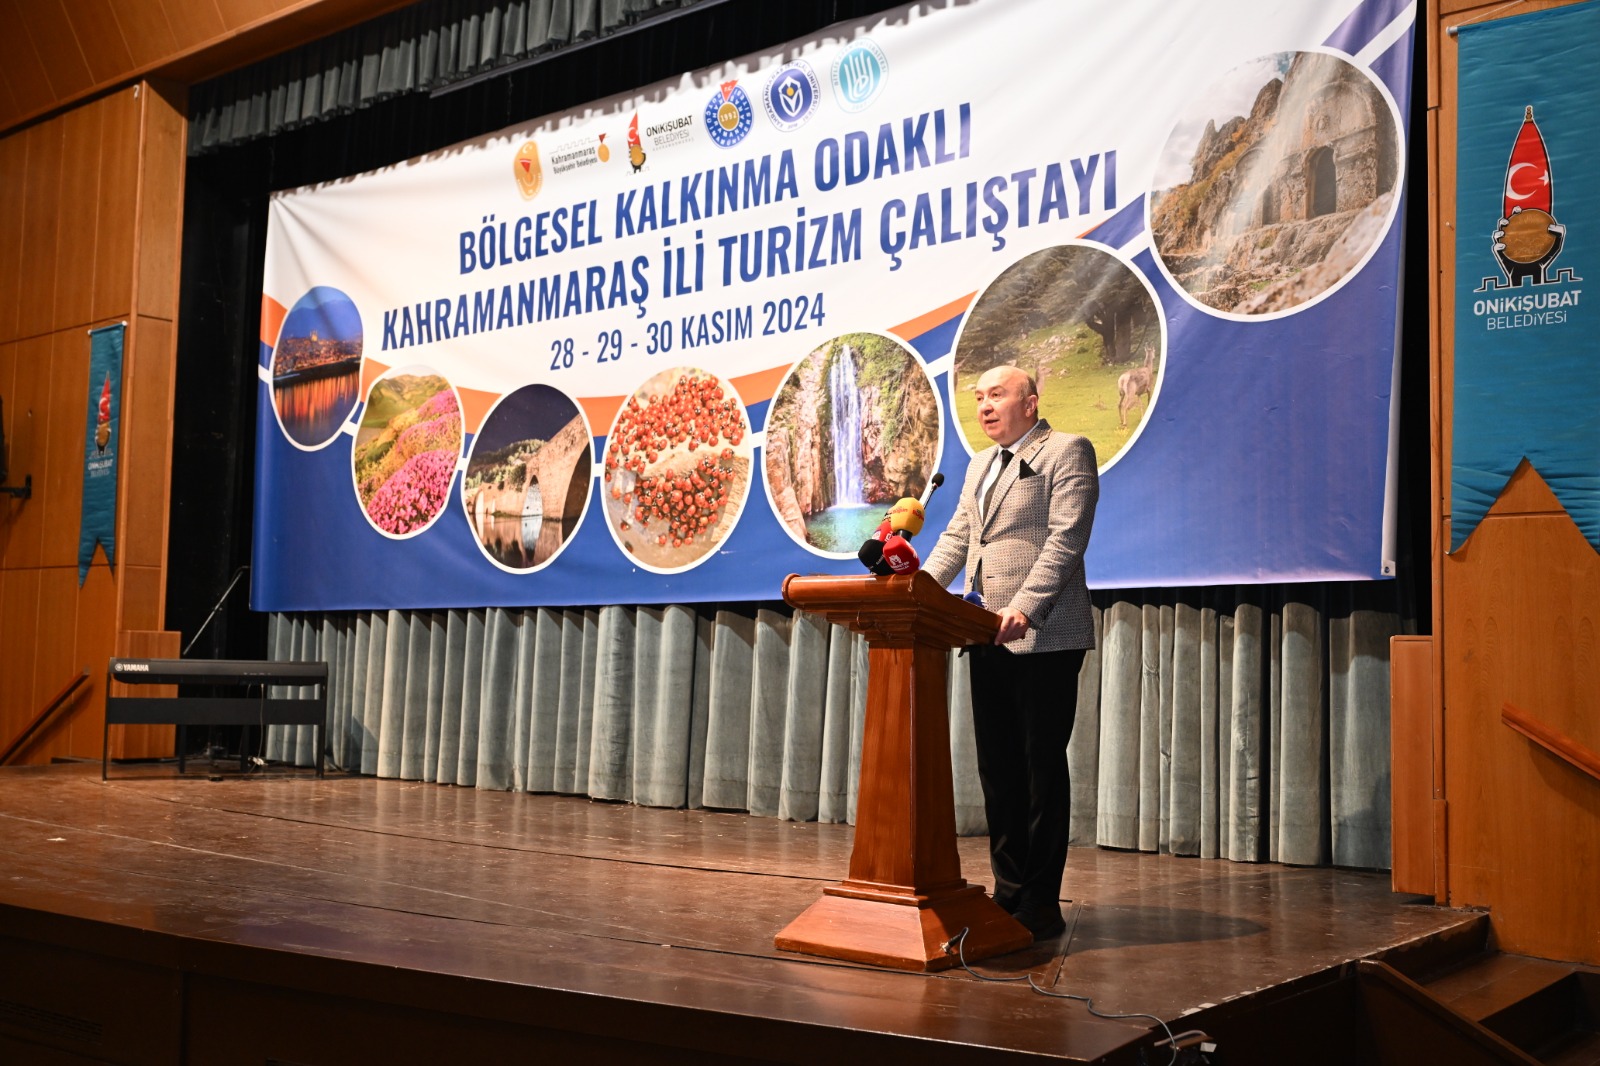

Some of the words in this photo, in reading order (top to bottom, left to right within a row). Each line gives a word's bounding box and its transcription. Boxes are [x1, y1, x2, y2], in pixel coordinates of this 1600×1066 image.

[720, 110, 737, 123] 1992
[551, 146, 596, 165] Kahramanmaraş
[459, 199, 603, 275] BÖLGESEL
[614, 149, 799, 239] KALKINMA
[814, 102, 971, 192] ODAKLI
[381, 255, 650, 350] KAHRAMANMARAŞ
[662, 229, 705, 298] İLİ
[718, 206, 862, 287] TURİZM
[879, 150, 1117, 271] ÇALIŞTAYI
[550, 337, 575, 370] 28
[596, 329, 623, 363] 29
[646, 320, 673, 355] 30
[681, 304, 753, 349] KASIM
[762, 292, 826, 336] 2024
[123, 663, 149, 672] YAMAHA
